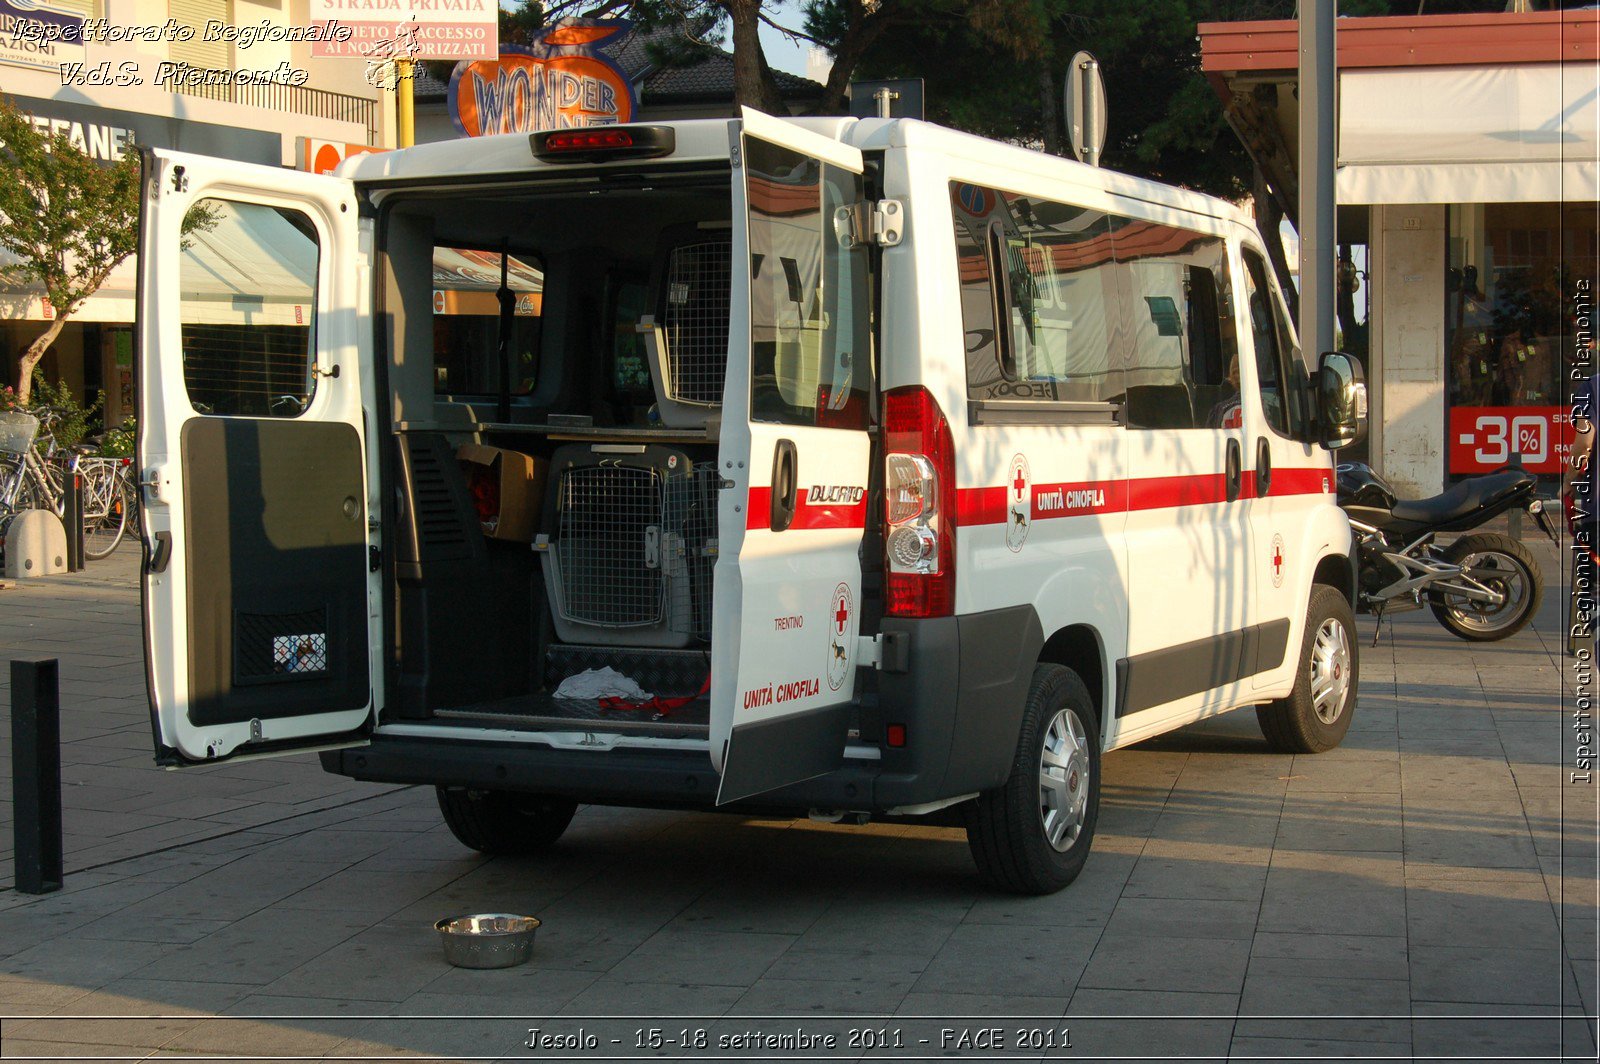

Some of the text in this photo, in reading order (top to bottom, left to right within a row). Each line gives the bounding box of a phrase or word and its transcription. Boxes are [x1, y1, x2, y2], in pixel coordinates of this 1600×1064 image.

[416, 27, 486, 39] ACCESSO
[325, 42, 341, 54] AI
[472, 63, 618, 137] WONDER
[809, 485, 864, 503] DUCATO
[1037, 487, 1105, 511] UNITÀ CINOFILA
[774, 615, 804, 631] TRENTINO
[743, 678, 819, 710] UNITÀ CINOFILA
